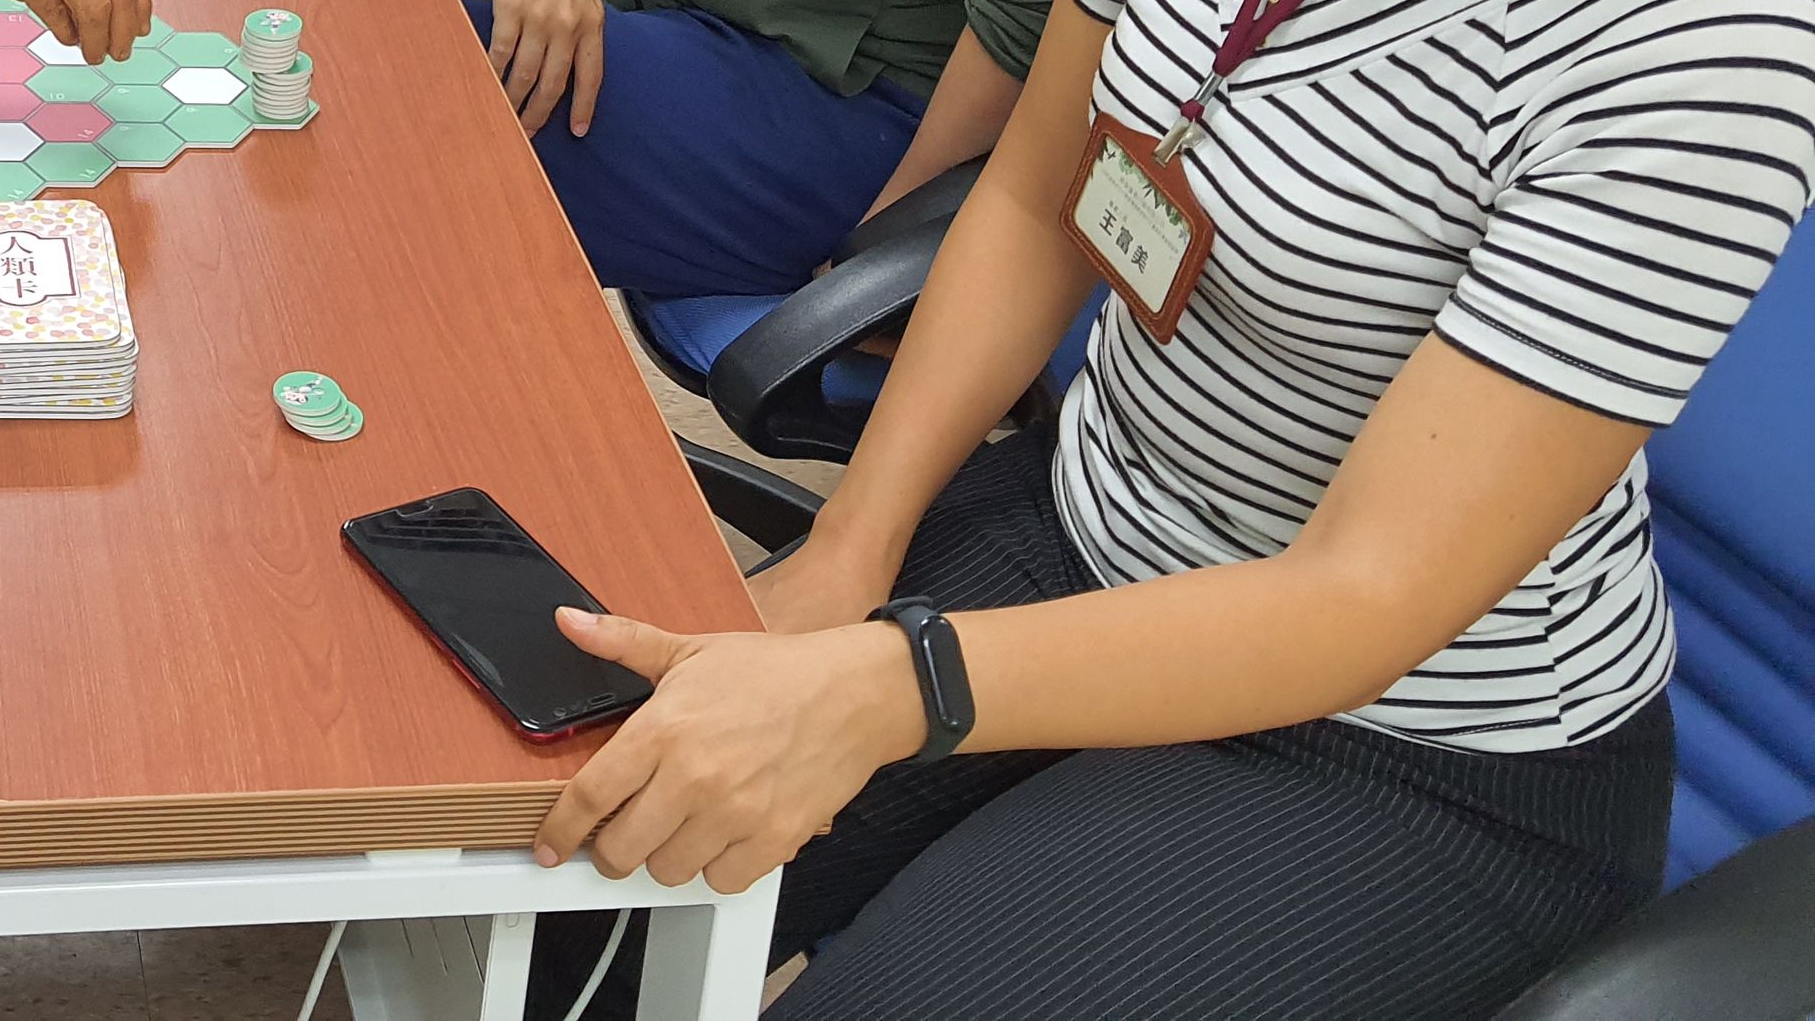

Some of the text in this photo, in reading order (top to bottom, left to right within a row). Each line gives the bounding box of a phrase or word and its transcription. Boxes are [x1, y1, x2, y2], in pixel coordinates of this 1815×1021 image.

[77, 128, 93, 139] 14
[79, 168, 95, 179] 14
[8, 188, 24, 200] 14
[1099, 209, 1150, 274] 王富美
[0, 236, 38, 298] 人類卡
